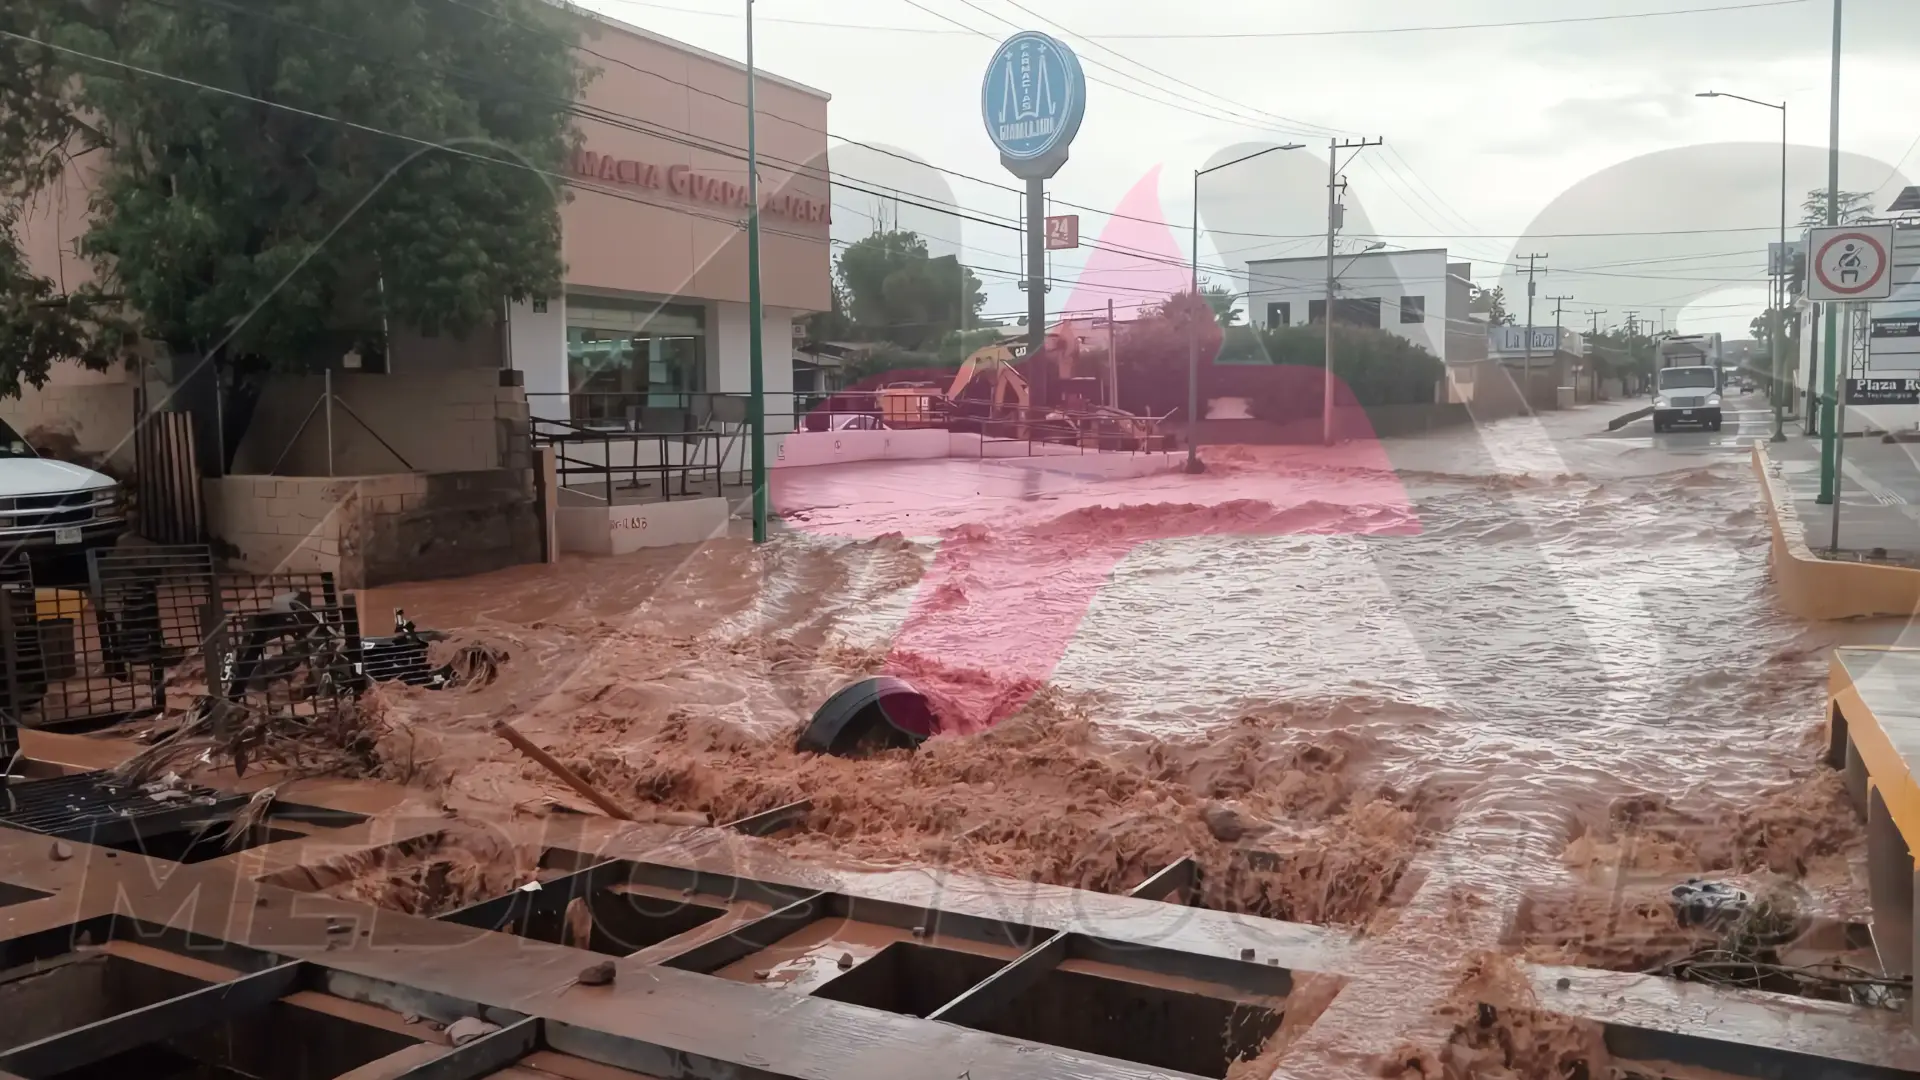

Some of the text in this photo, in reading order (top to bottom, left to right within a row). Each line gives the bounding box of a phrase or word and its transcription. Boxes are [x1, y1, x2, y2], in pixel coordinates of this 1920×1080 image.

[1021, 43, 1031, 110] FARMACIAS
[1051, 217, 1068, 238] 24
[1856, 379, 1897, 391] Plaza
